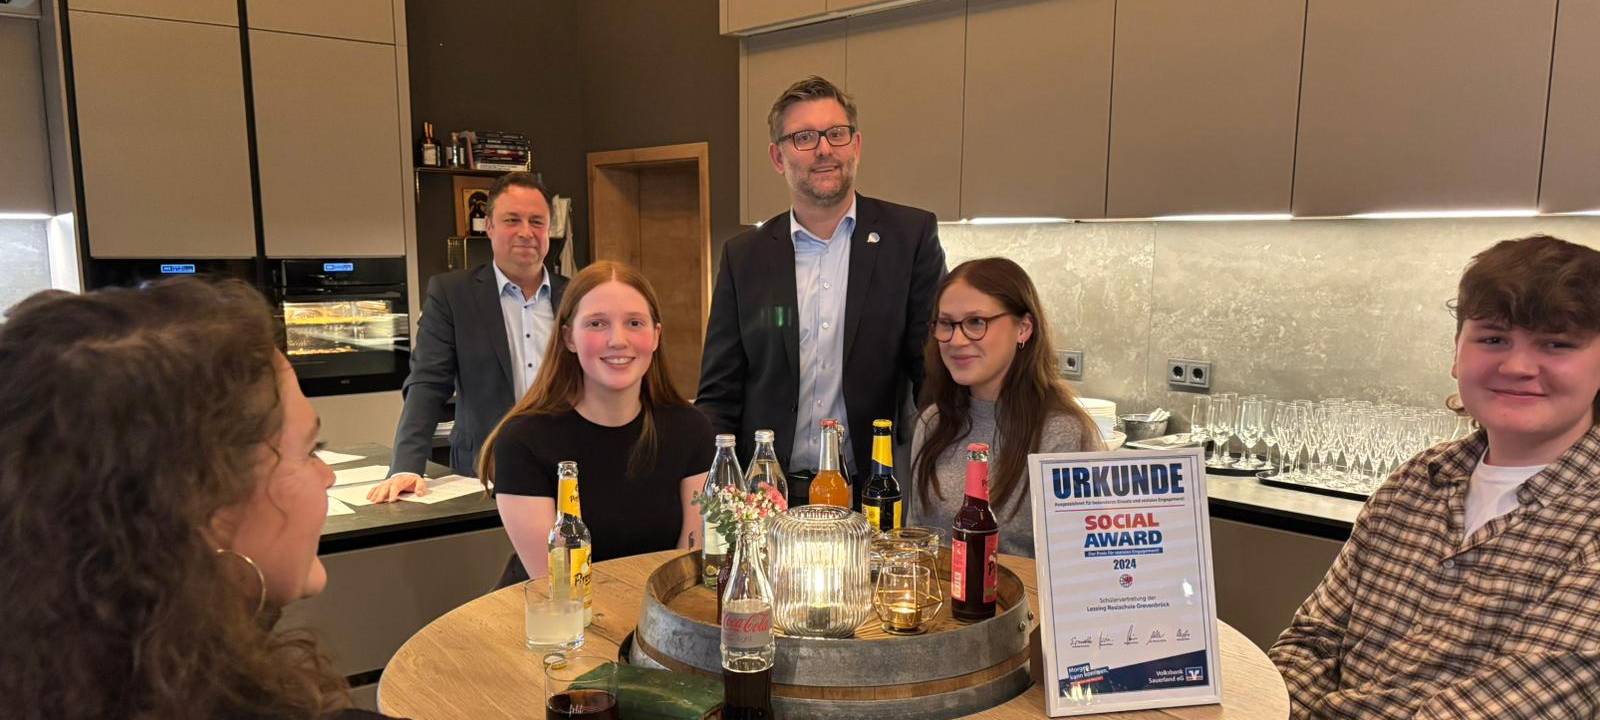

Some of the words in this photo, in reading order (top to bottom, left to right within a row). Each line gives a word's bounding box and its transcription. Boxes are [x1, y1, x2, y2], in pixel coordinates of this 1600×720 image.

[1052, 463, 1185, 499] URKUNDE
[1085, 512, 1159, 530] SOCIAL
[1084, 530, 1163, 548] AWARD
[1113, 558, 1137, 570] 2024
[1156, 668, 1183, 676] Volksbank
